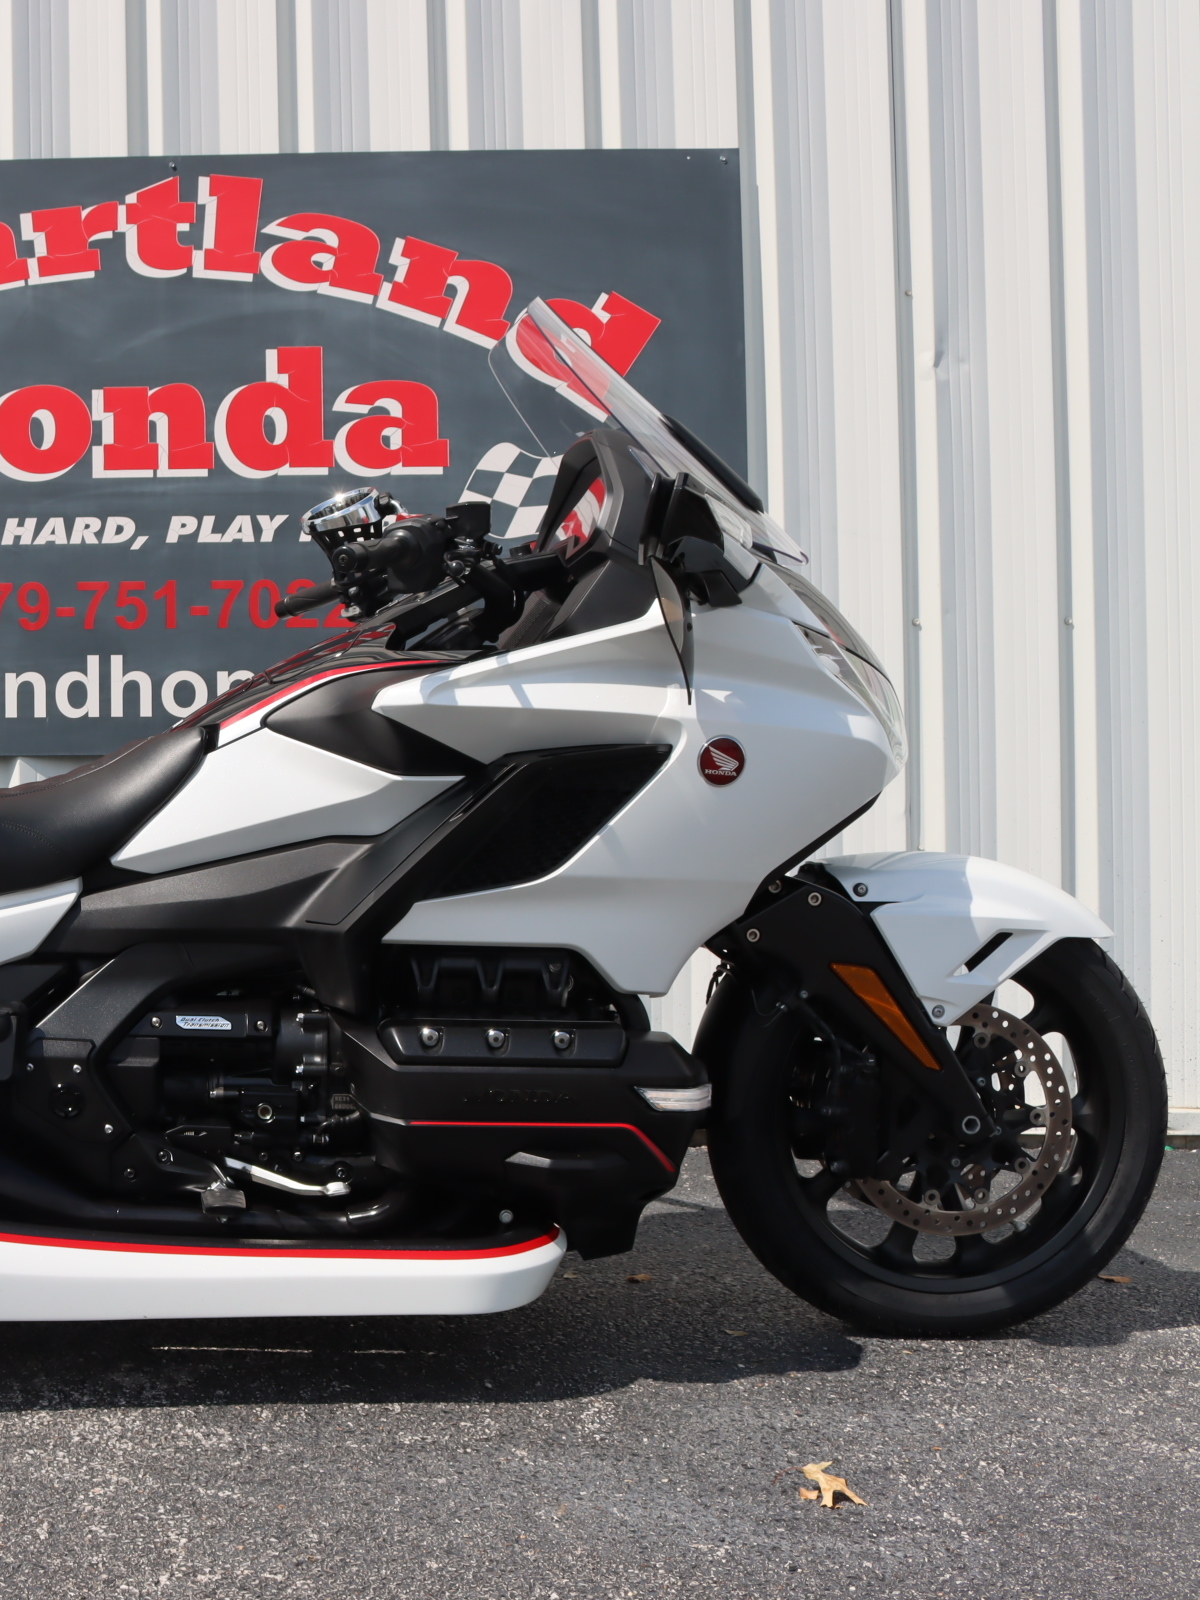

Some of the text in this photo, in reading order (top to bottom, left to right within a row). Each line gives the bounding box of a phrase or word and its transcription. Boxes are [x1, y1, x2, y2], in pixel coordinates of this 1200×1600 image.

[1, 517, 149, 550] HARD,
[165, 515, 289, 544] PLAY
[704, 768, 738, 777] HONDA
